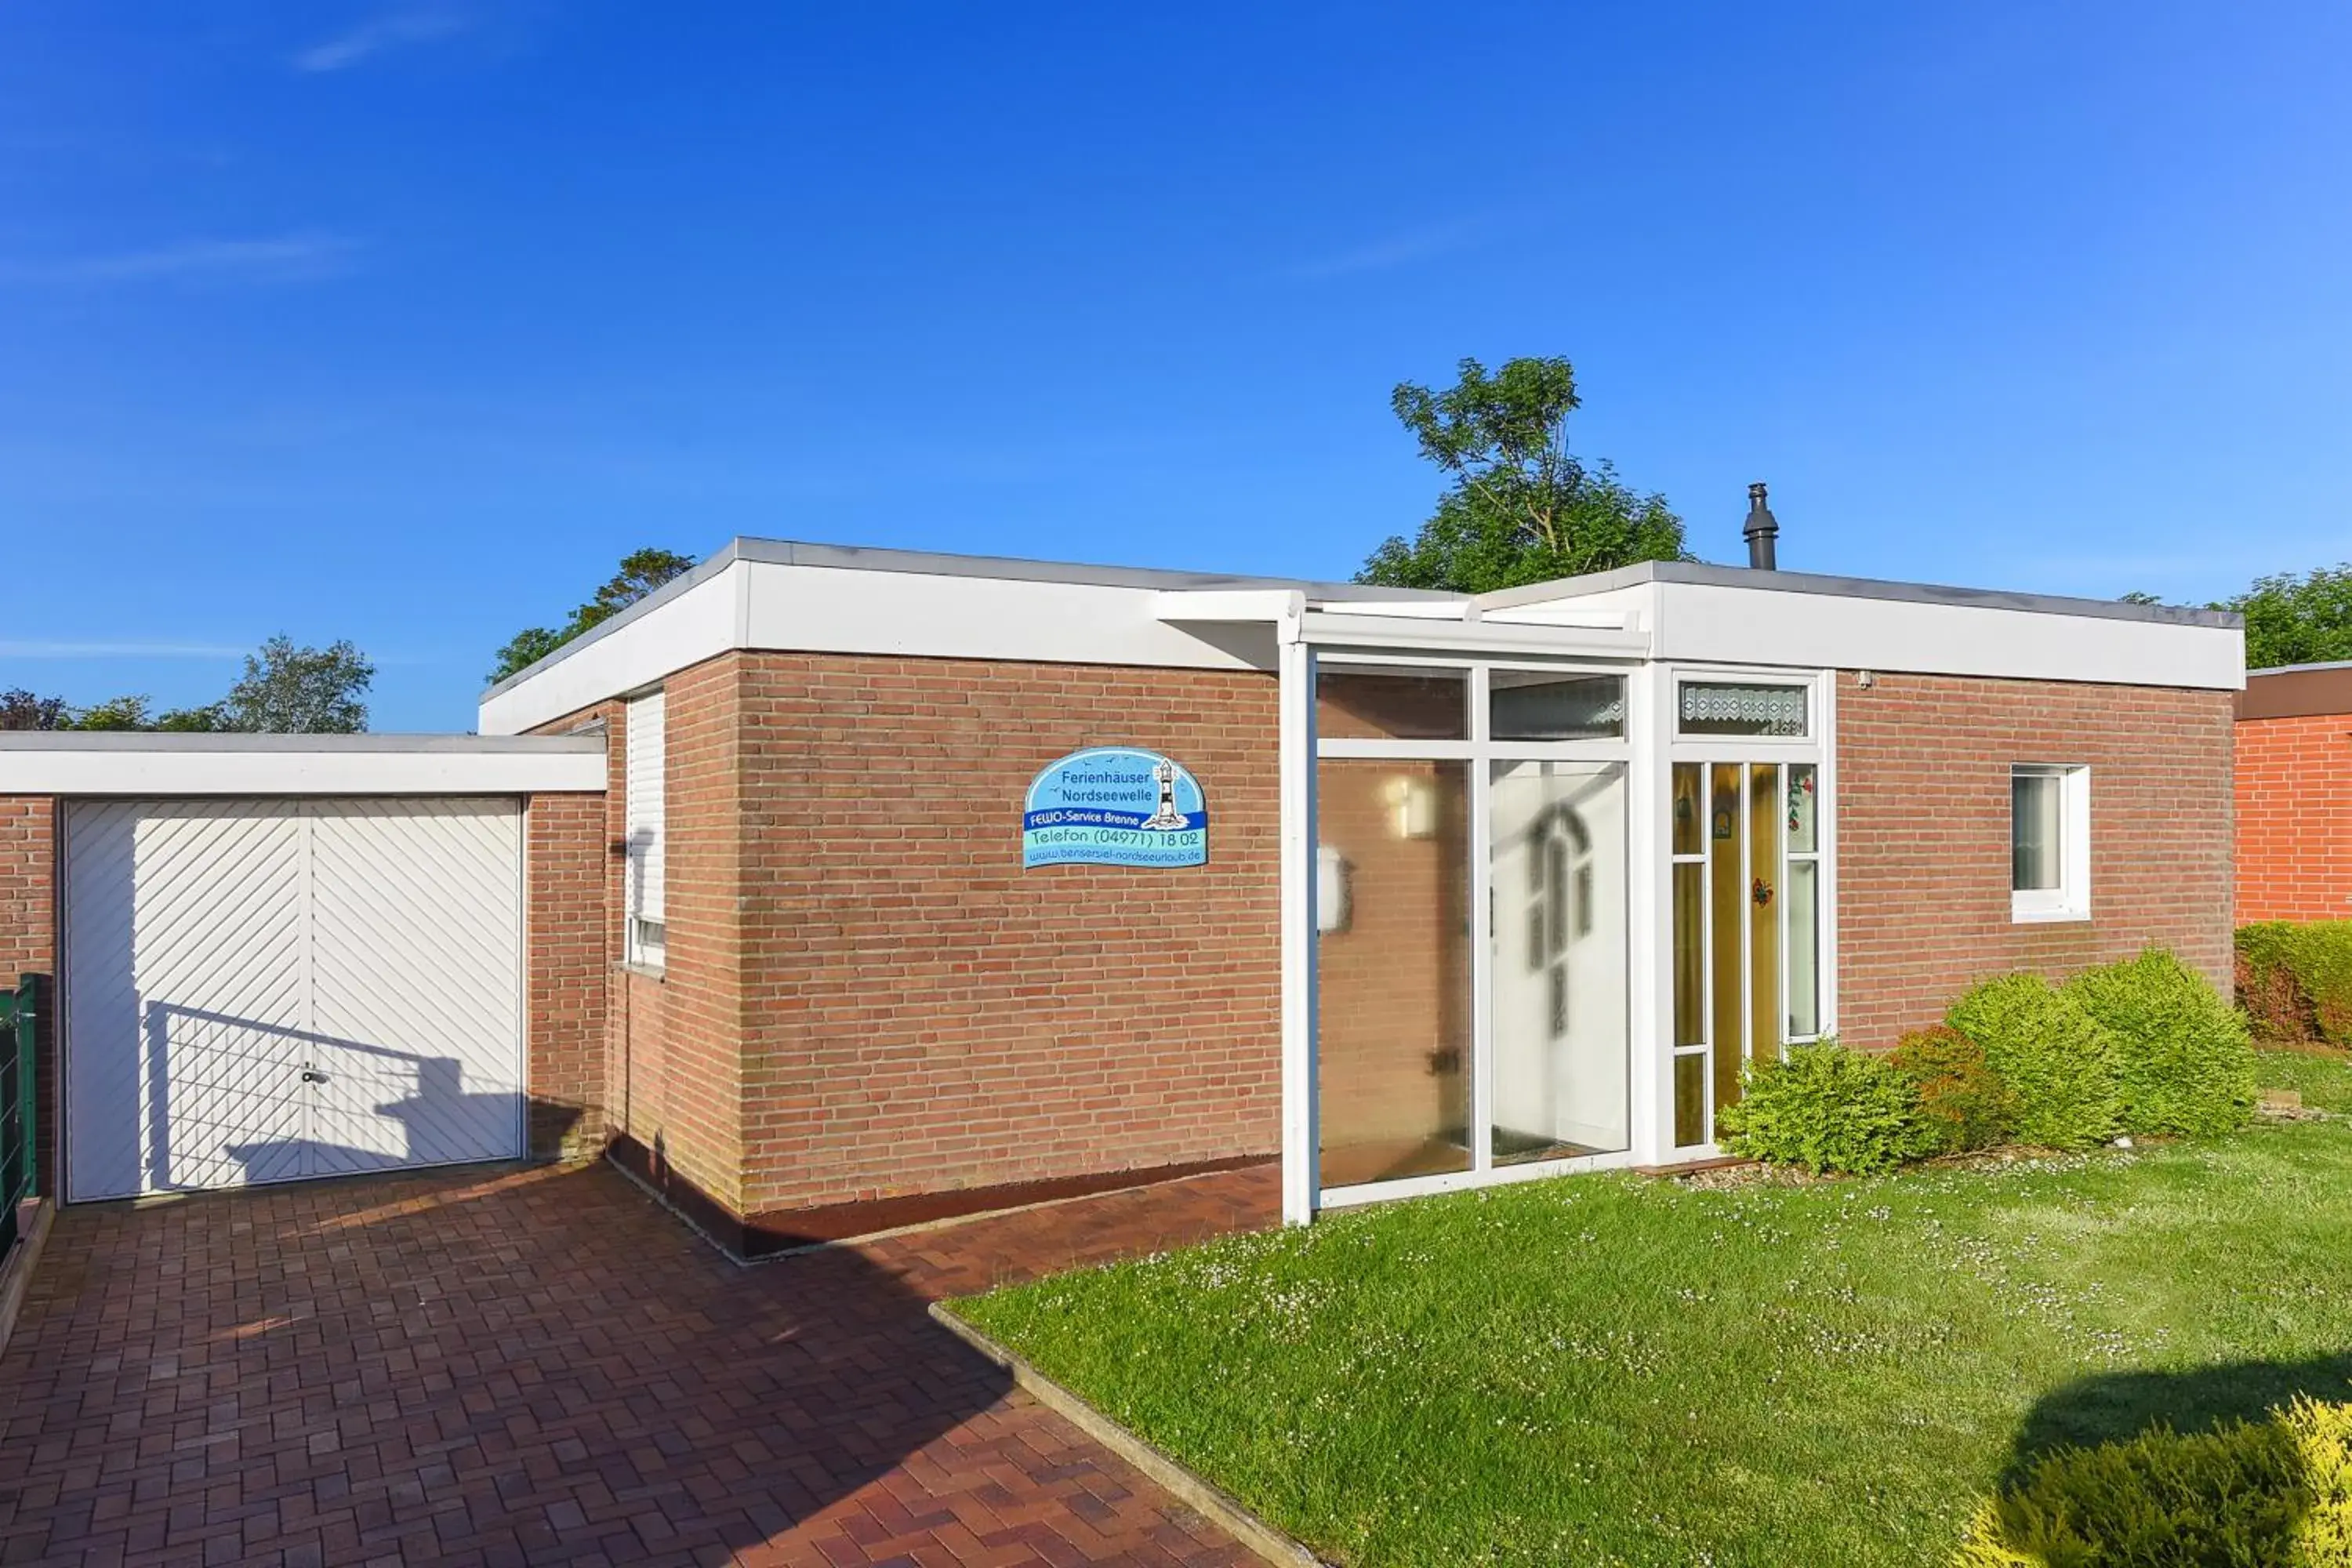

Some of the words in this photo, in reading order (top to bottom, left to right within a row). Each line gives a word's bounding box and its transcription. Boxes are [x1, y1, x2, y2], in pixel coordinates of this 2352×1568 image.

[1062, 771, 1150, 784] Ferienhäuser
[1062, 789, 1152, 802] Nordseewelle
[1030, 812, 1102, 826] FEWO-Service
[1104, 812, 1139, 826] Brenne
[1032, 829, 1088, 844] Telefon
[1094, 829, 1153, 848] (04971)
